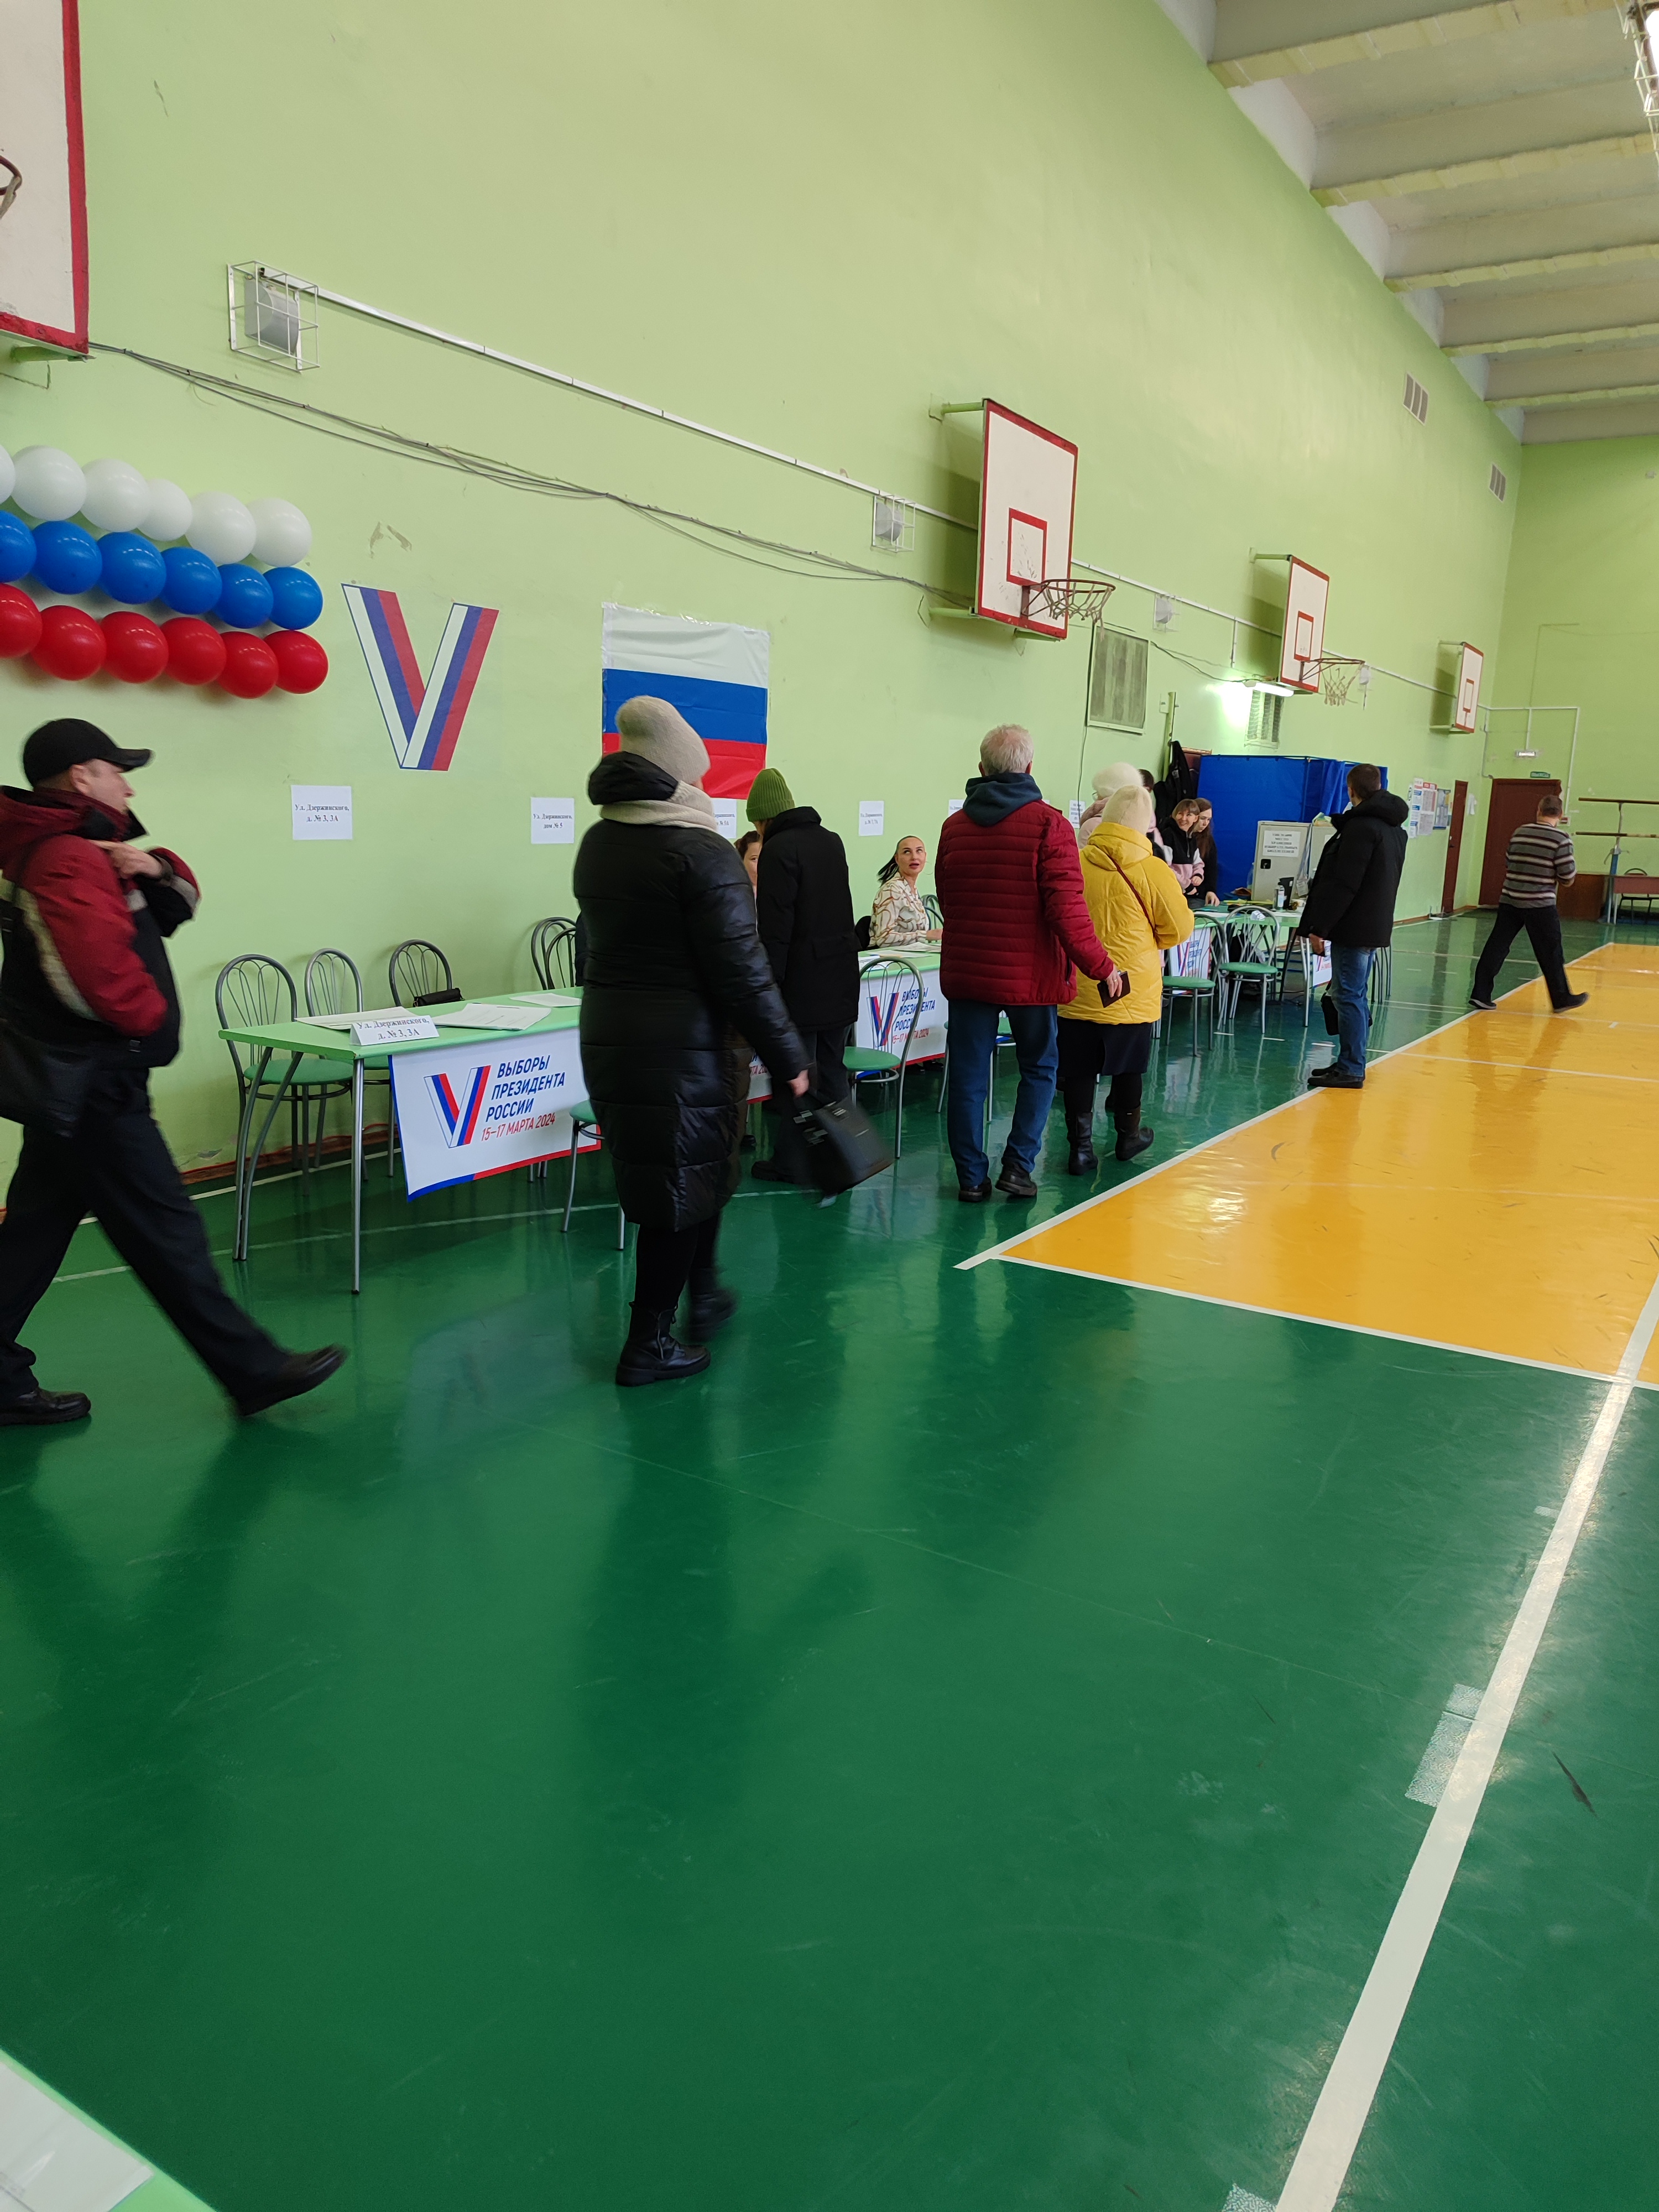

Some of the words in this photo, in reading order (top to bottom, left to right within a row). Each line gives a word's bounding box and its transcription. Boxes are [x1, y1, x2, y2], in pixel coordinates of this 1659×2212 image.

[902, 987, 928, 1001] ВЫБОЫ
[899, 1000, 935, 1016] ПРЕЗИЕНТА
[374, 1018, 430, 1029] Дзержинского,
[387, 1030, 398, 1039] №
[398, 1029, 407, 1038] 3,
[497, 1055, 550, 1078] ВЫБОРЫ
[491, 1072, 565, 1100] ПРЕЗИДЕНТА
[486, 1098, 534, 1123] РОССИИ
[506, 1117, 535, 1136] МАРТА
[535, 1112, 556, 1129] 2024
